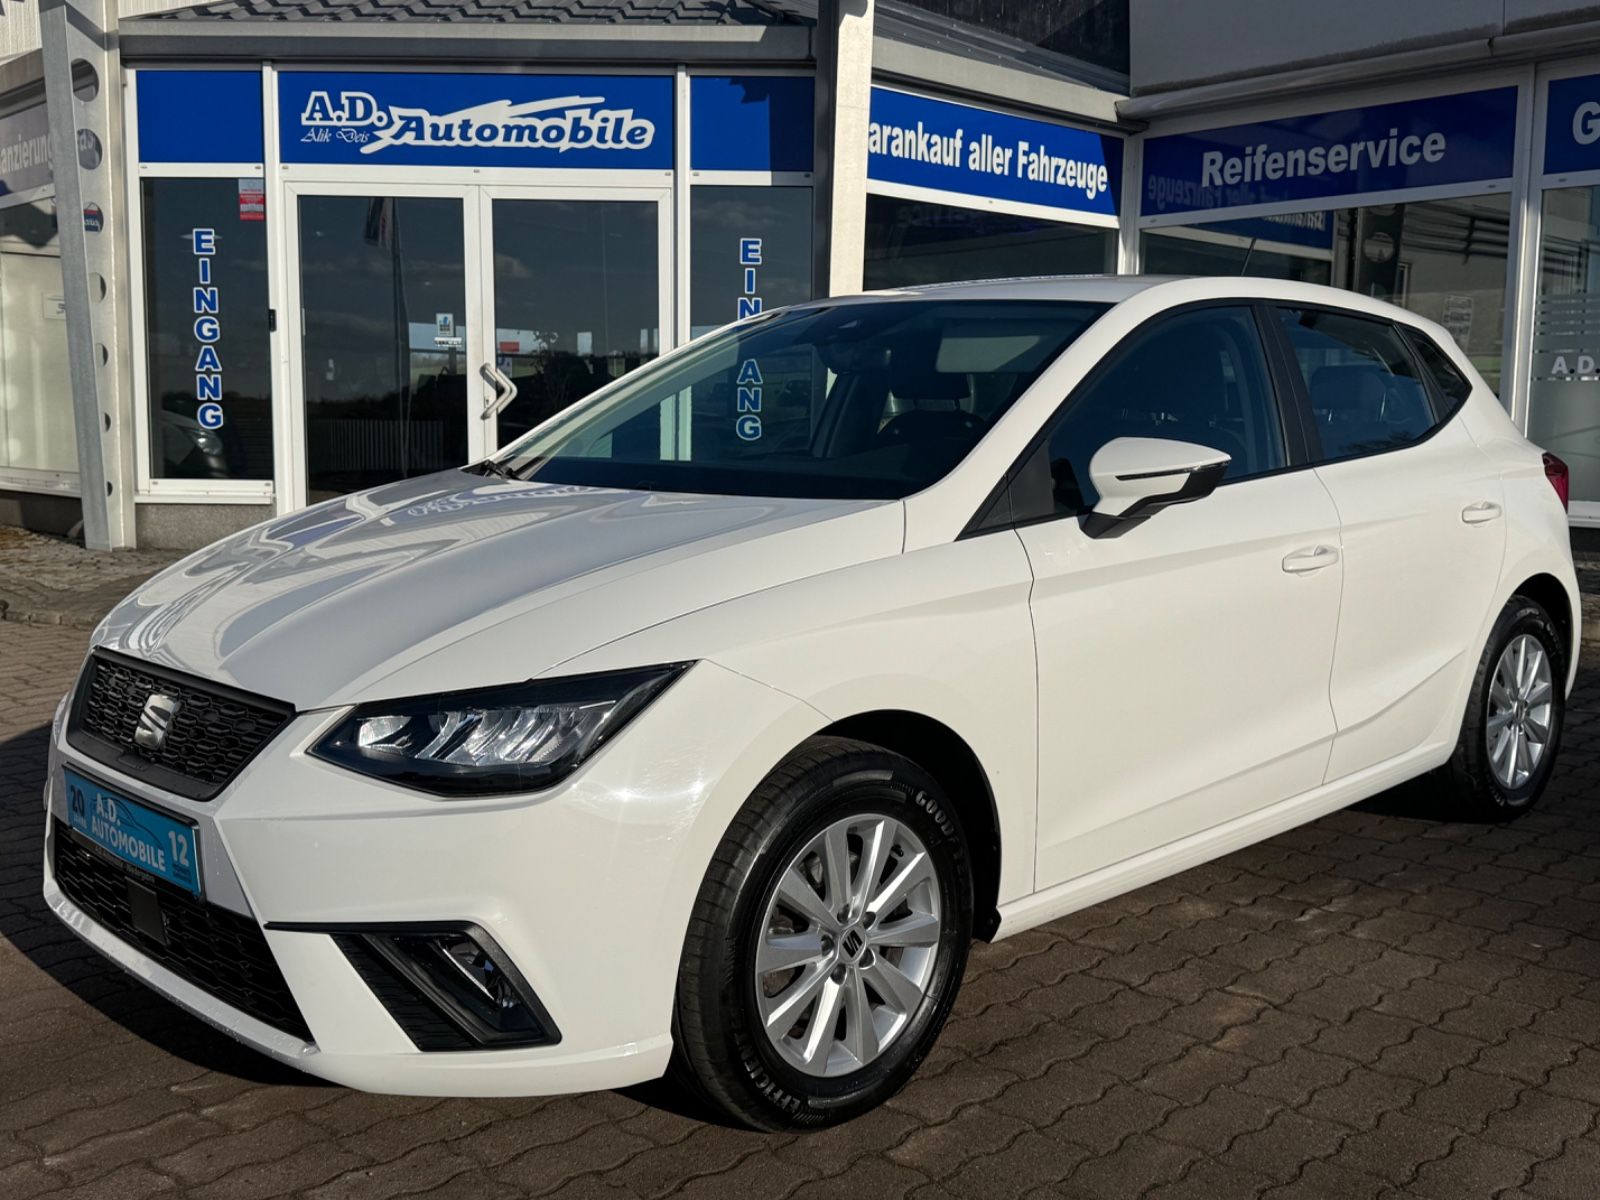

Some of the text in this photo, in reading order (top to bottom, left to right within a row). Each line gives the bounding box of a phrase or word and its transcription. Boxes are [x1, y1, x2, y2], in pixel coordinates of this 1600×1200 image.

[300, 127, 332, 144] Alik
[301, 91, 655, 151] A.D. Automobile
[0, 132, 53, 176] anzierun
[867, 120, 1108, 200] arankauf aller Fahrzeuge
[1201, 127, 1446, 188] Reifenservice
[192, 228, 224, 430] EINGANG
[736, 237, 764, 441] EINANG
[91, 815, 167, 873] AUTOMOBILE
[168, 830, 190, 867] 12
